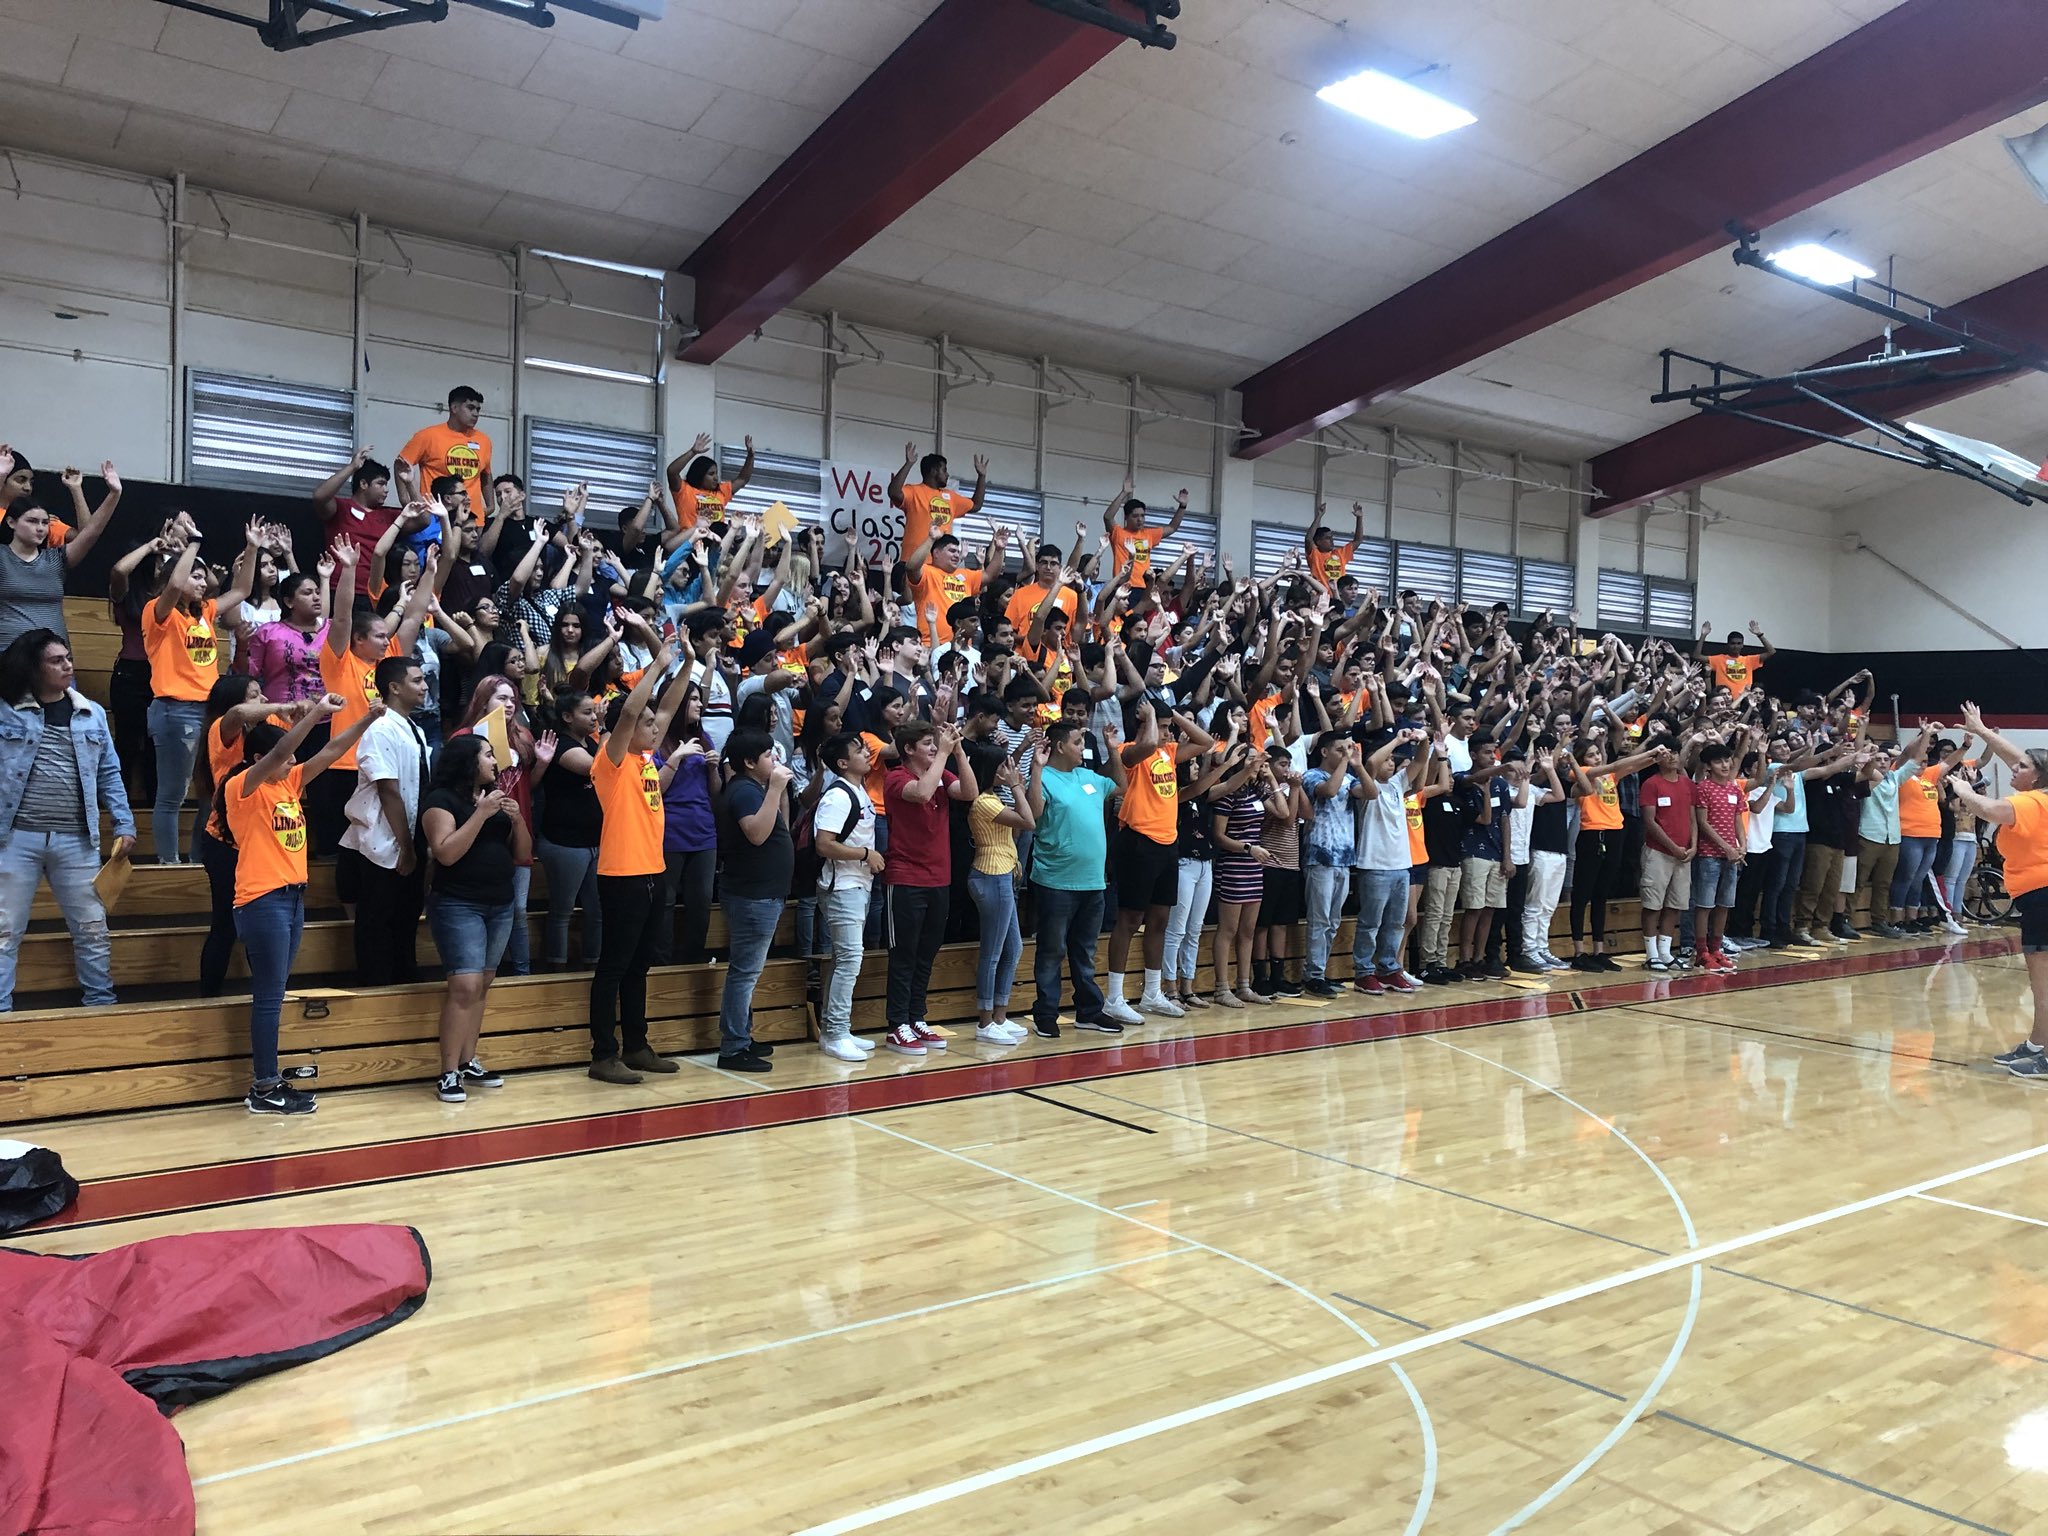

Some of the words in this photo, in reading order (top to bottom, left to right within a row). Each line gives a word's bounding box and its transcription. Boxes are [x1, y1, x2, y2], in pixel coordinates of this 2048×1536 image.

[446, 455, 461, 466] LINK
[462, 457, 480, 469] CREW
[831, 508, 906, 542] Class
[943, 582, 956, 591] LINK
[187, 636, 205, 648] LINK
[274, 815, 296, 831] LINK
